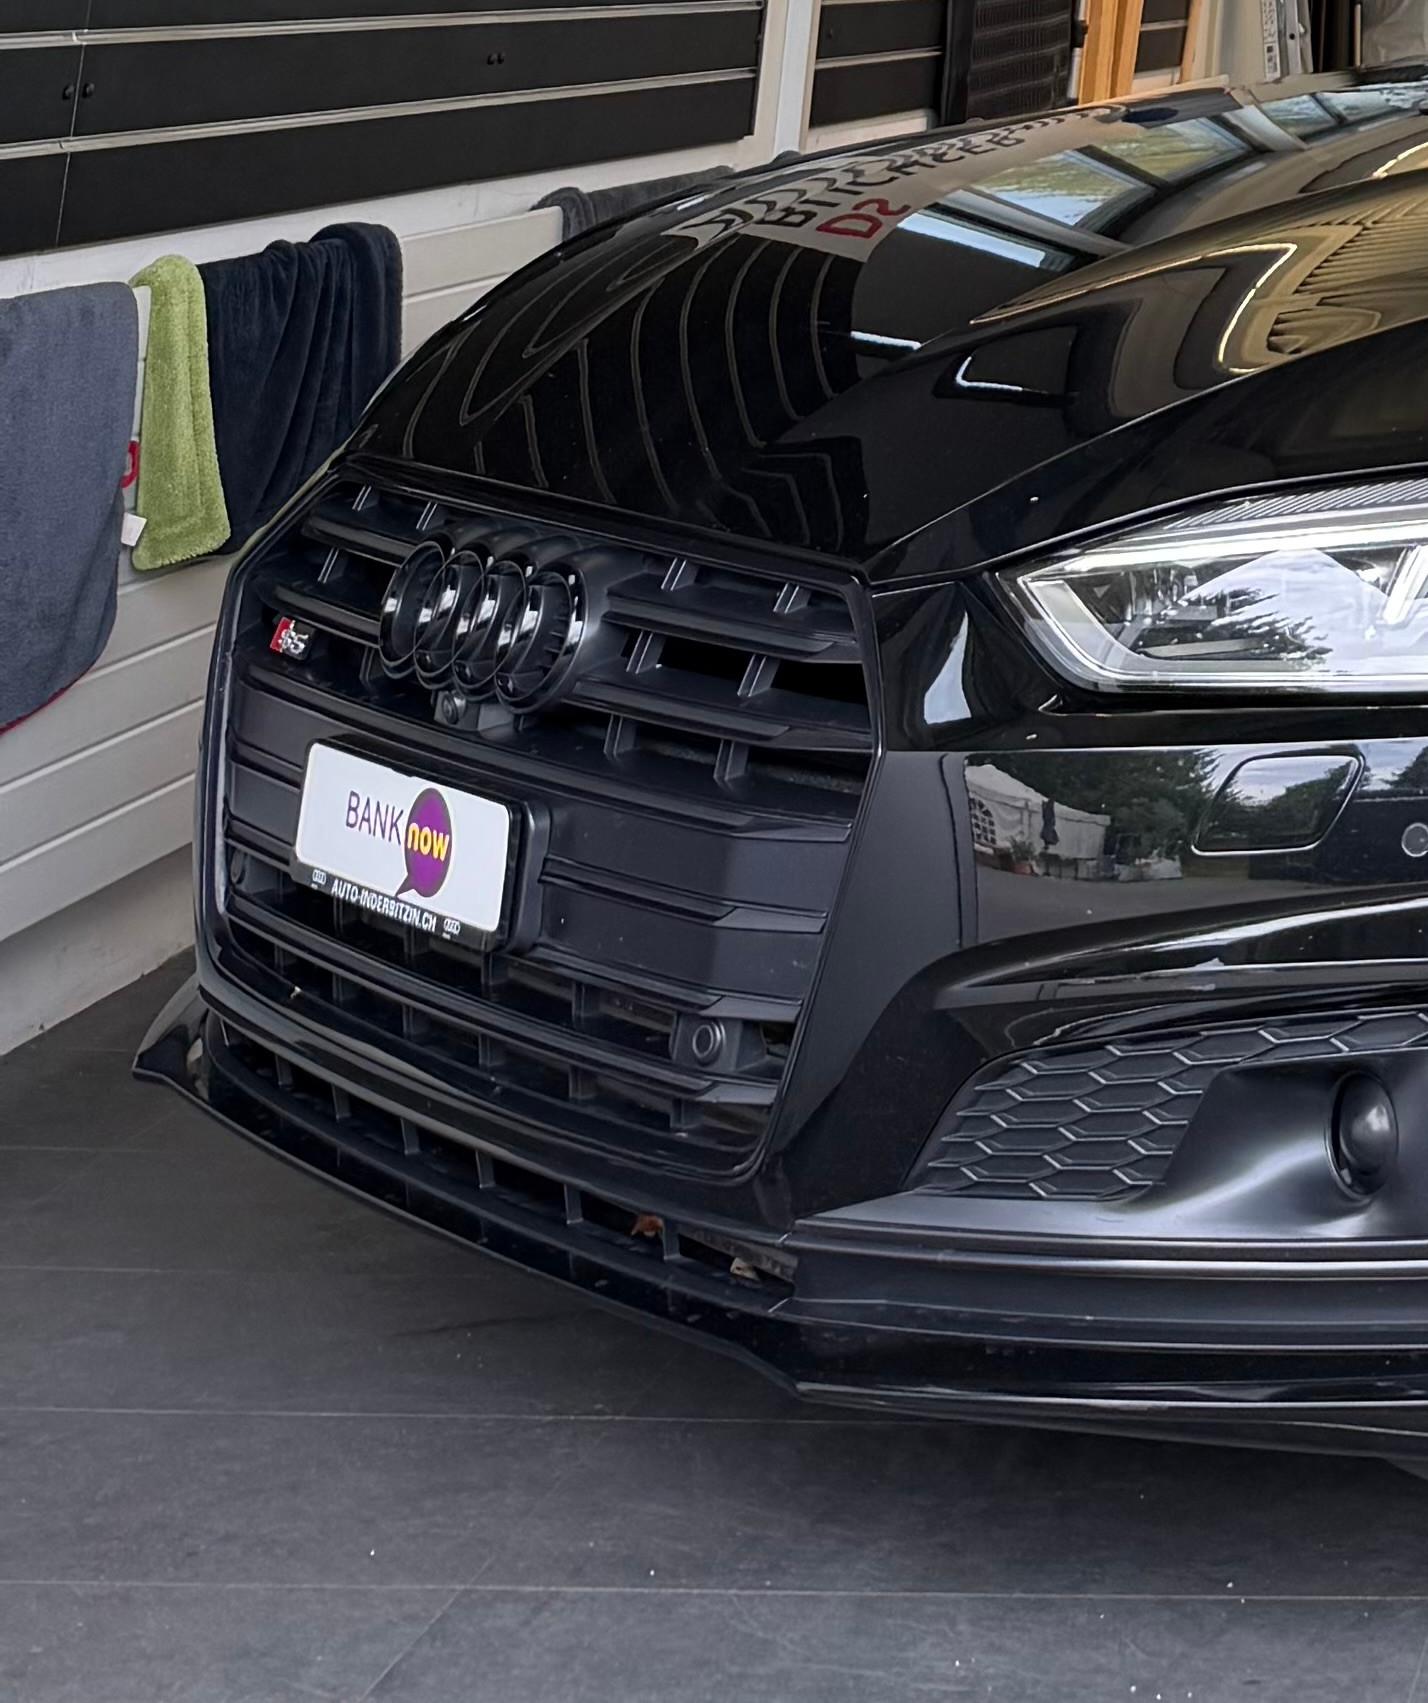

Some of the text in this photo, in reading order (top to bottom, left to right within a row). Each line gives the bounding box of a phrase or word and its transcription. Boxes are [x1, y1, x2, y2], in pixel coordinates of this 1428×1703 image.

[345, 790, 450, 862] BANK now
[331, 878, 437, 933] AUTO-INDERBITZIN.CH
